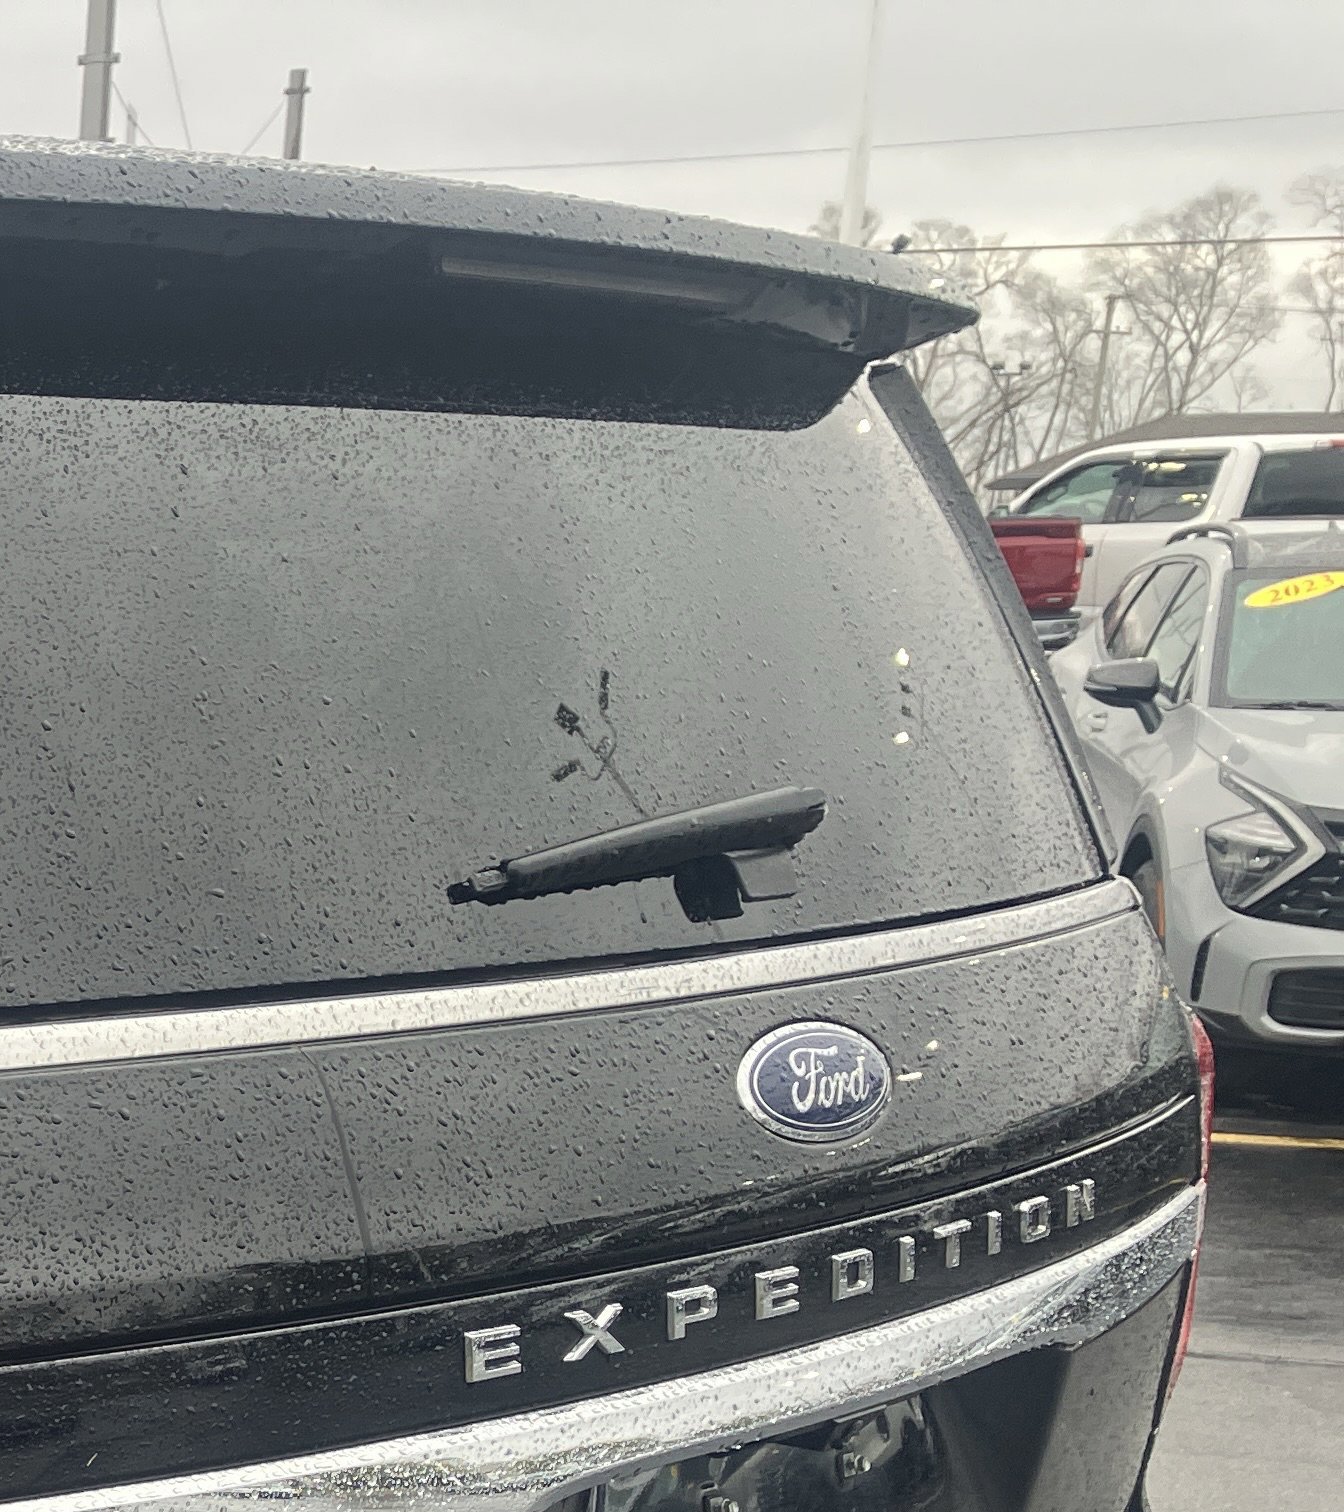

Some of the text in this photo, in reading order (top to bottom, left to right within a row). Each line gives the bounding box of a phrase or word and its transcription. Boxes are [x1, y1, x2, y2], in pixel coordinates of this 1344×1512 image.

[1269, 574, 1335, 603] 2023
[788, 1045, 870, 1113] Ford
[463, 1178, 1097, 1384] EXPEDITION
